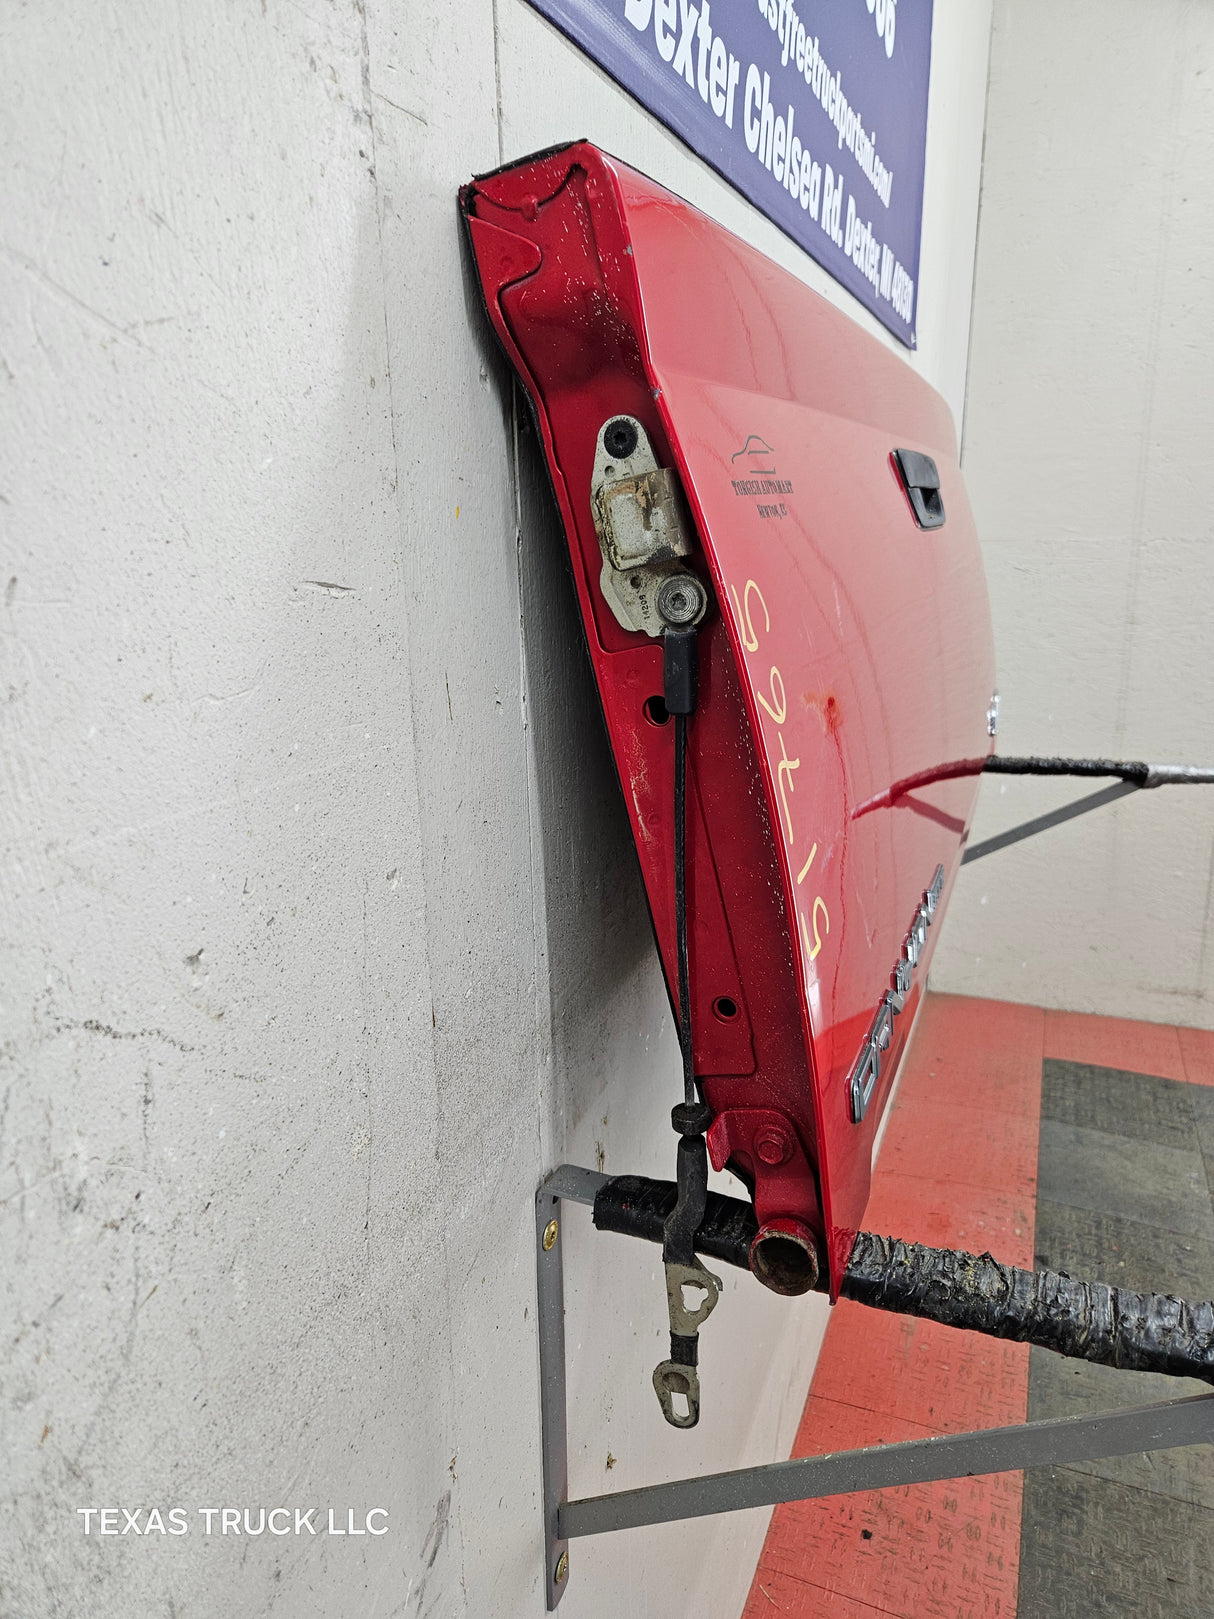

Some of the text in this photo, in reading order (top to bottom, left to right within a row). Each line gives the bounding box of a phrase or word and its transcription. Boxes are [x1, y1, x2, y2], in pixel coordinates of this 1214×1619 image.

[624, 0, 741, 130] exter
[744, 63, 823, 223] Chelsea
[821, 163, 844, 248] Rd.
[844, 194, 881, 298] Dexter,
[879, 243, 895, 302] MI
